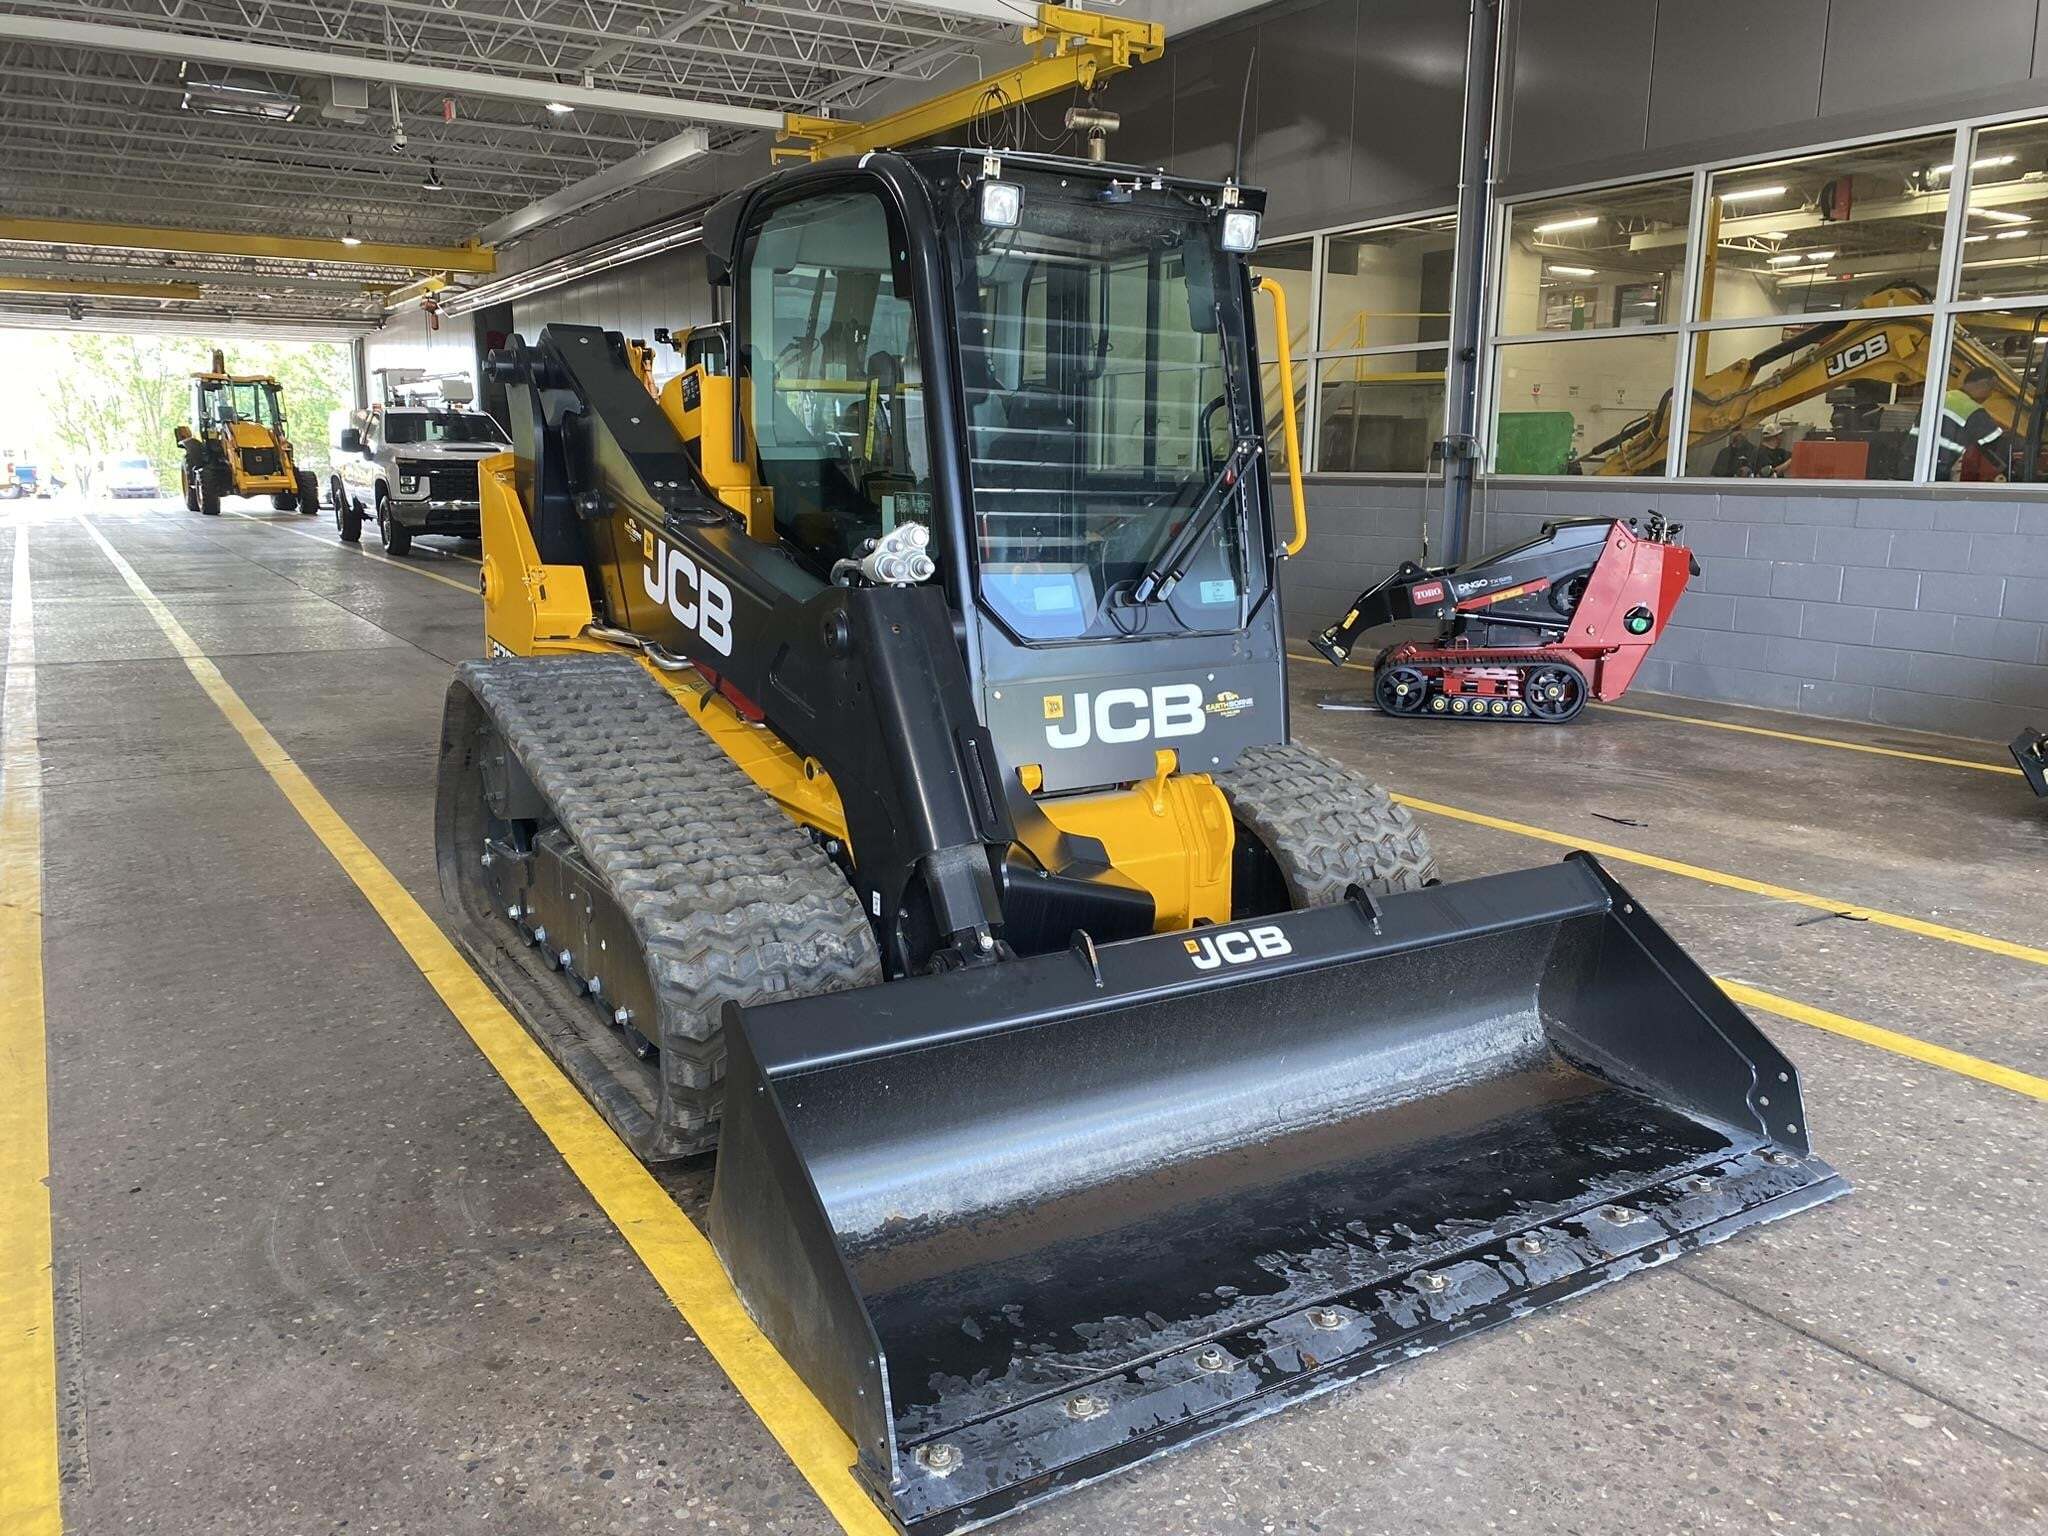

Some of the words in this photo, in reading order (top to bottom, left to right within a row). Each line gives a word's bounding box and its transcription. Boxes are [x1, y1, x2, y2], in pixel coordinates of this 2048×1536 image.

[1828, 334, 1888, 376] JCB
[643, 538, 732, 657] JCB
[1414, 586, 1442, 600] TORO
[1045, 683, 1206, 749] JCB
[1190, 926, 1293, 970] JCB
